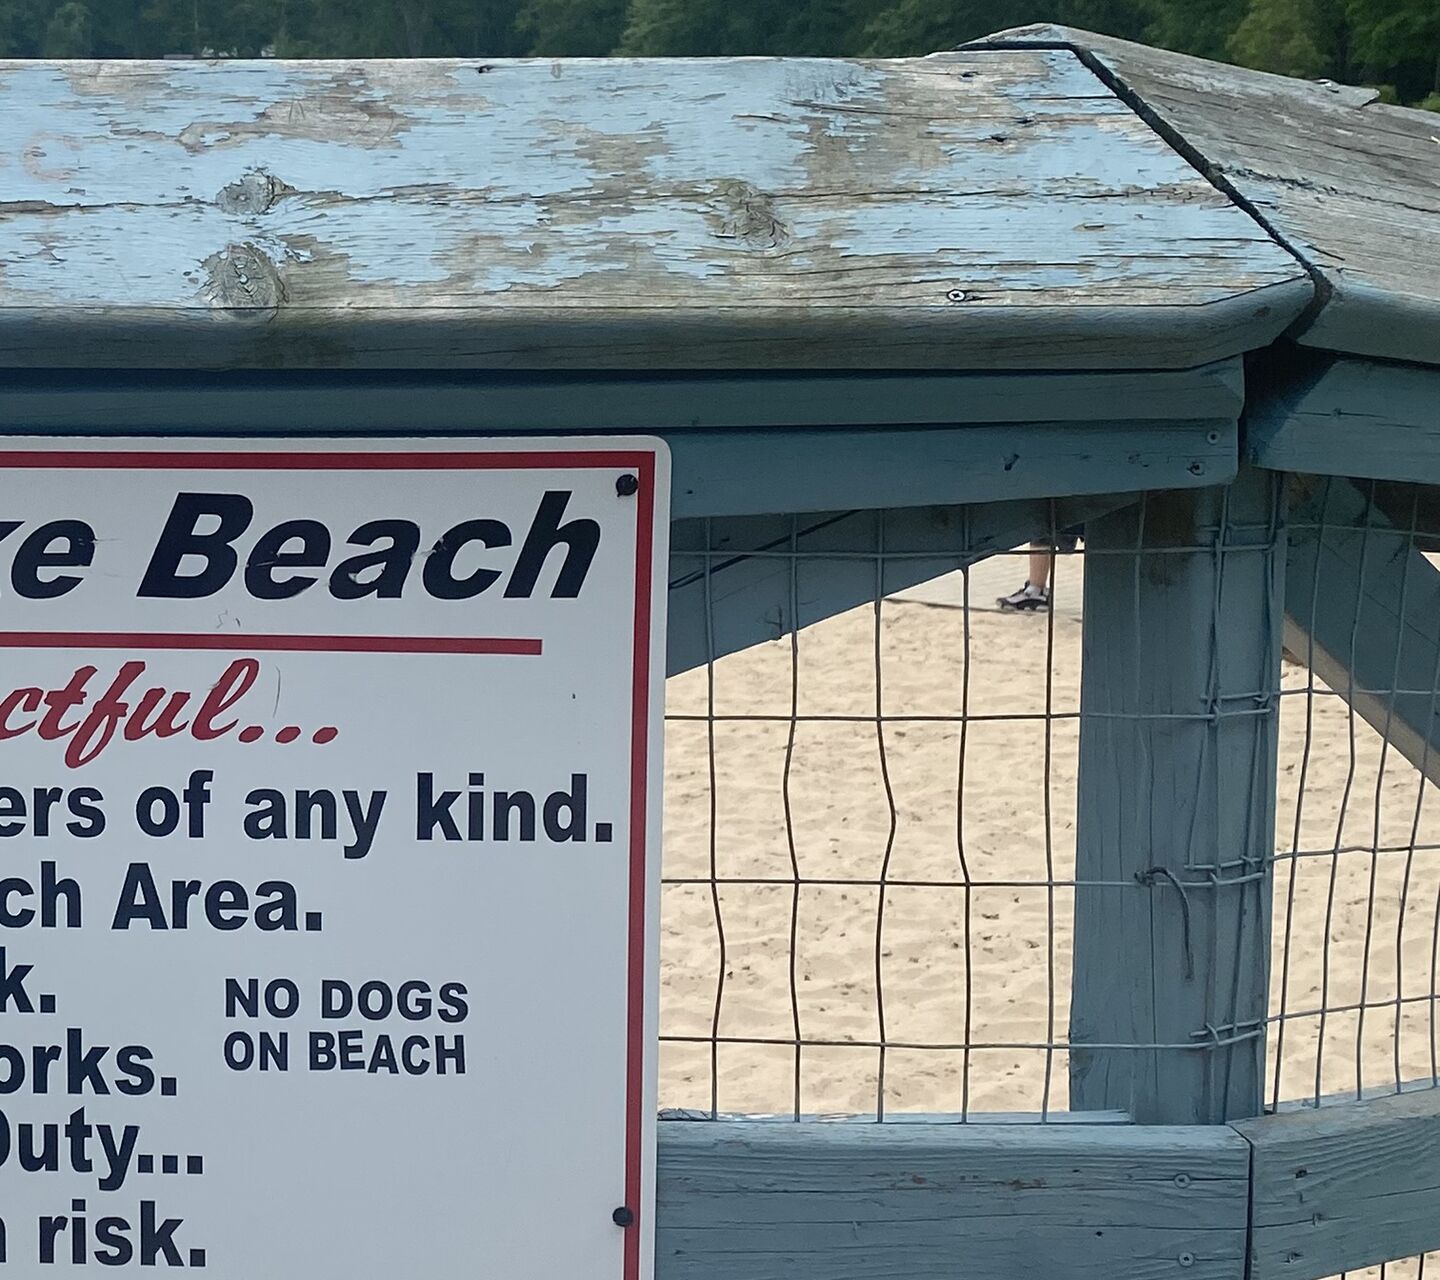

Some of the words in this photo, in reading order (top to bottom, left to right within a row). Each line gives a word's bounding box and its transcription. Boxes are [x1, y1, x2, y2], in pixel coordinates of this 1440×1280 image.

[135, 490, 601, 601] Beach
[135, 769, 214, 839] of
[243, 788, 388, 860] any
[416, 771, 613, 843] kind.
[111, 862, 323, 932] Area.
[225, 978, 300, 1019] NO
[321, 979, 469, 1024] DOGS
[223, 1031, 289, 1072] ON
[308, 1029, 466, 1076] BEACH
[38, 1198, 206, 1268] risk.
